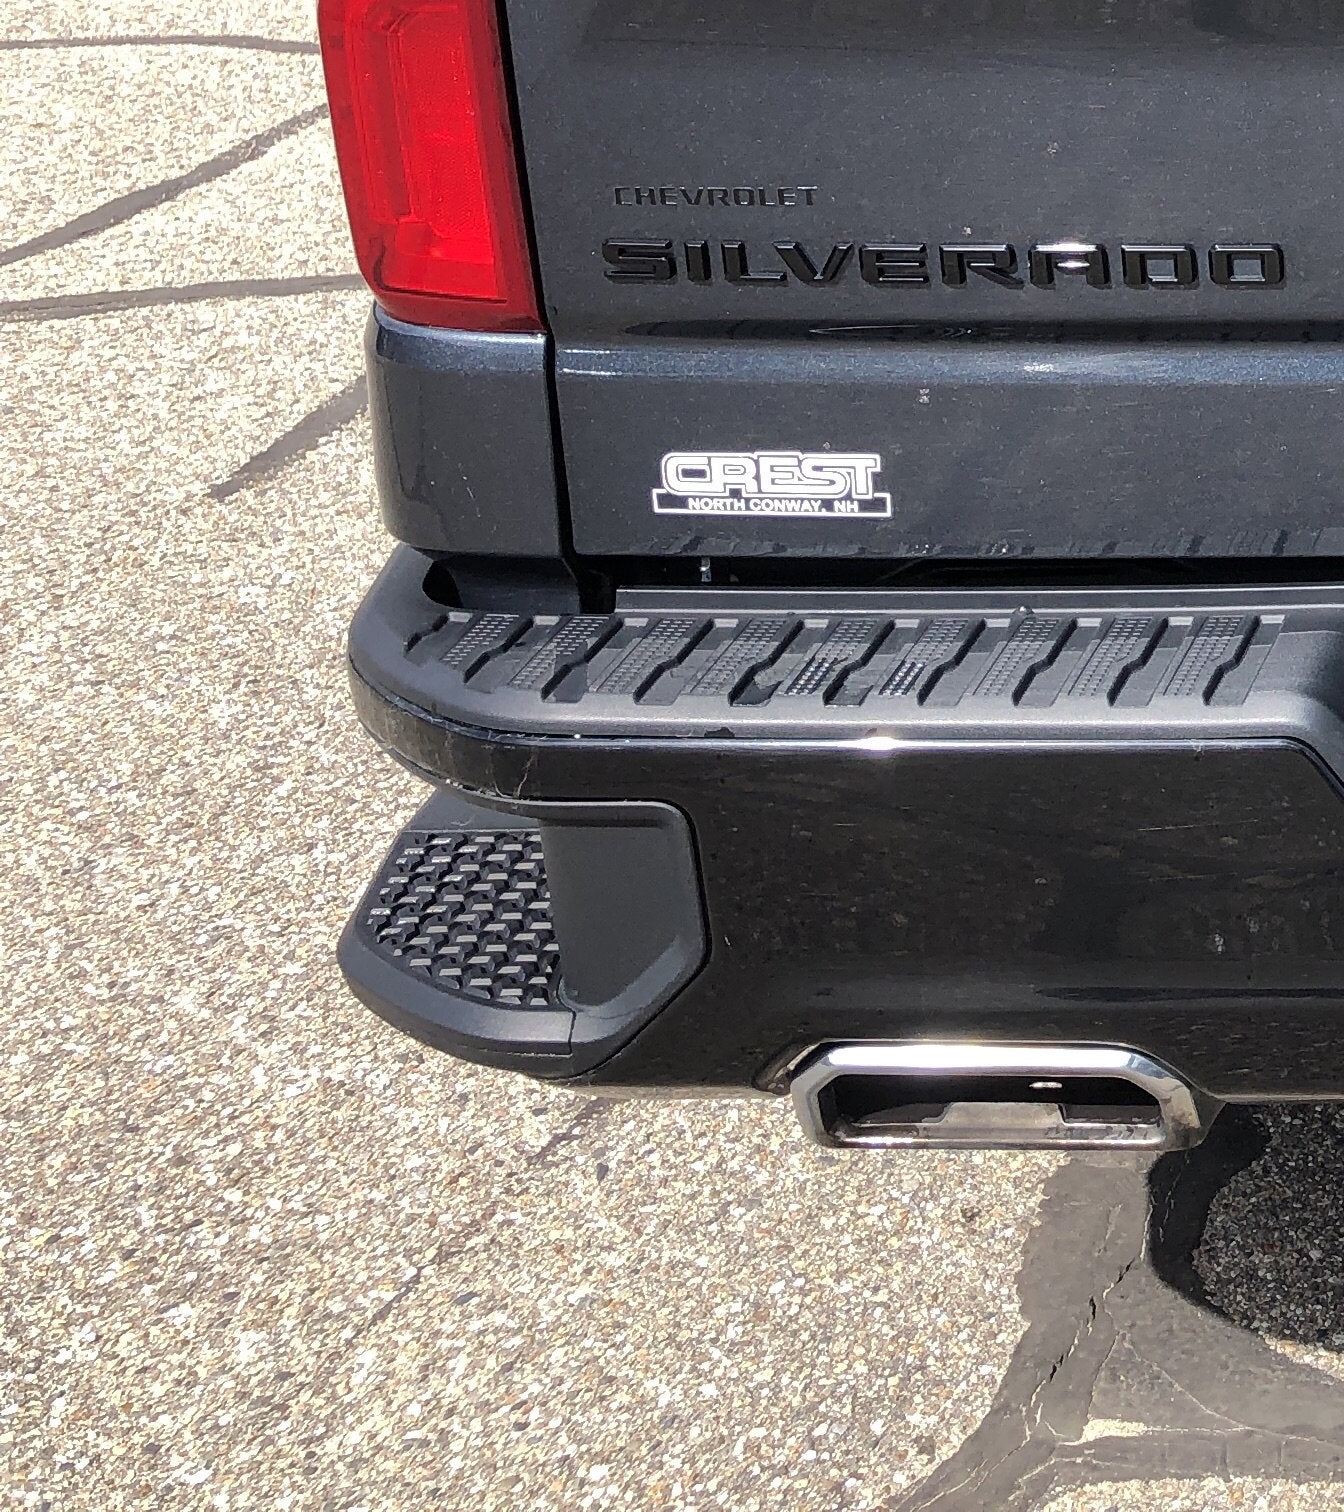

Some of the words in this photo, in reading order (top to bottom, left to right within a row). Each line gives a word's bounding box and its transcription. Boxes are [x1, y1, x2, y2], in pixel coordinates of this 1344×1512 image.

[613, 186, 818, 207] CHEVROLET
[600, 236, 1286, 288] SILVERADO
[662, 451, 881, 499] CREST
[688, 497, 746, 512] NORTH
[833, 500, 859, 513] NH
